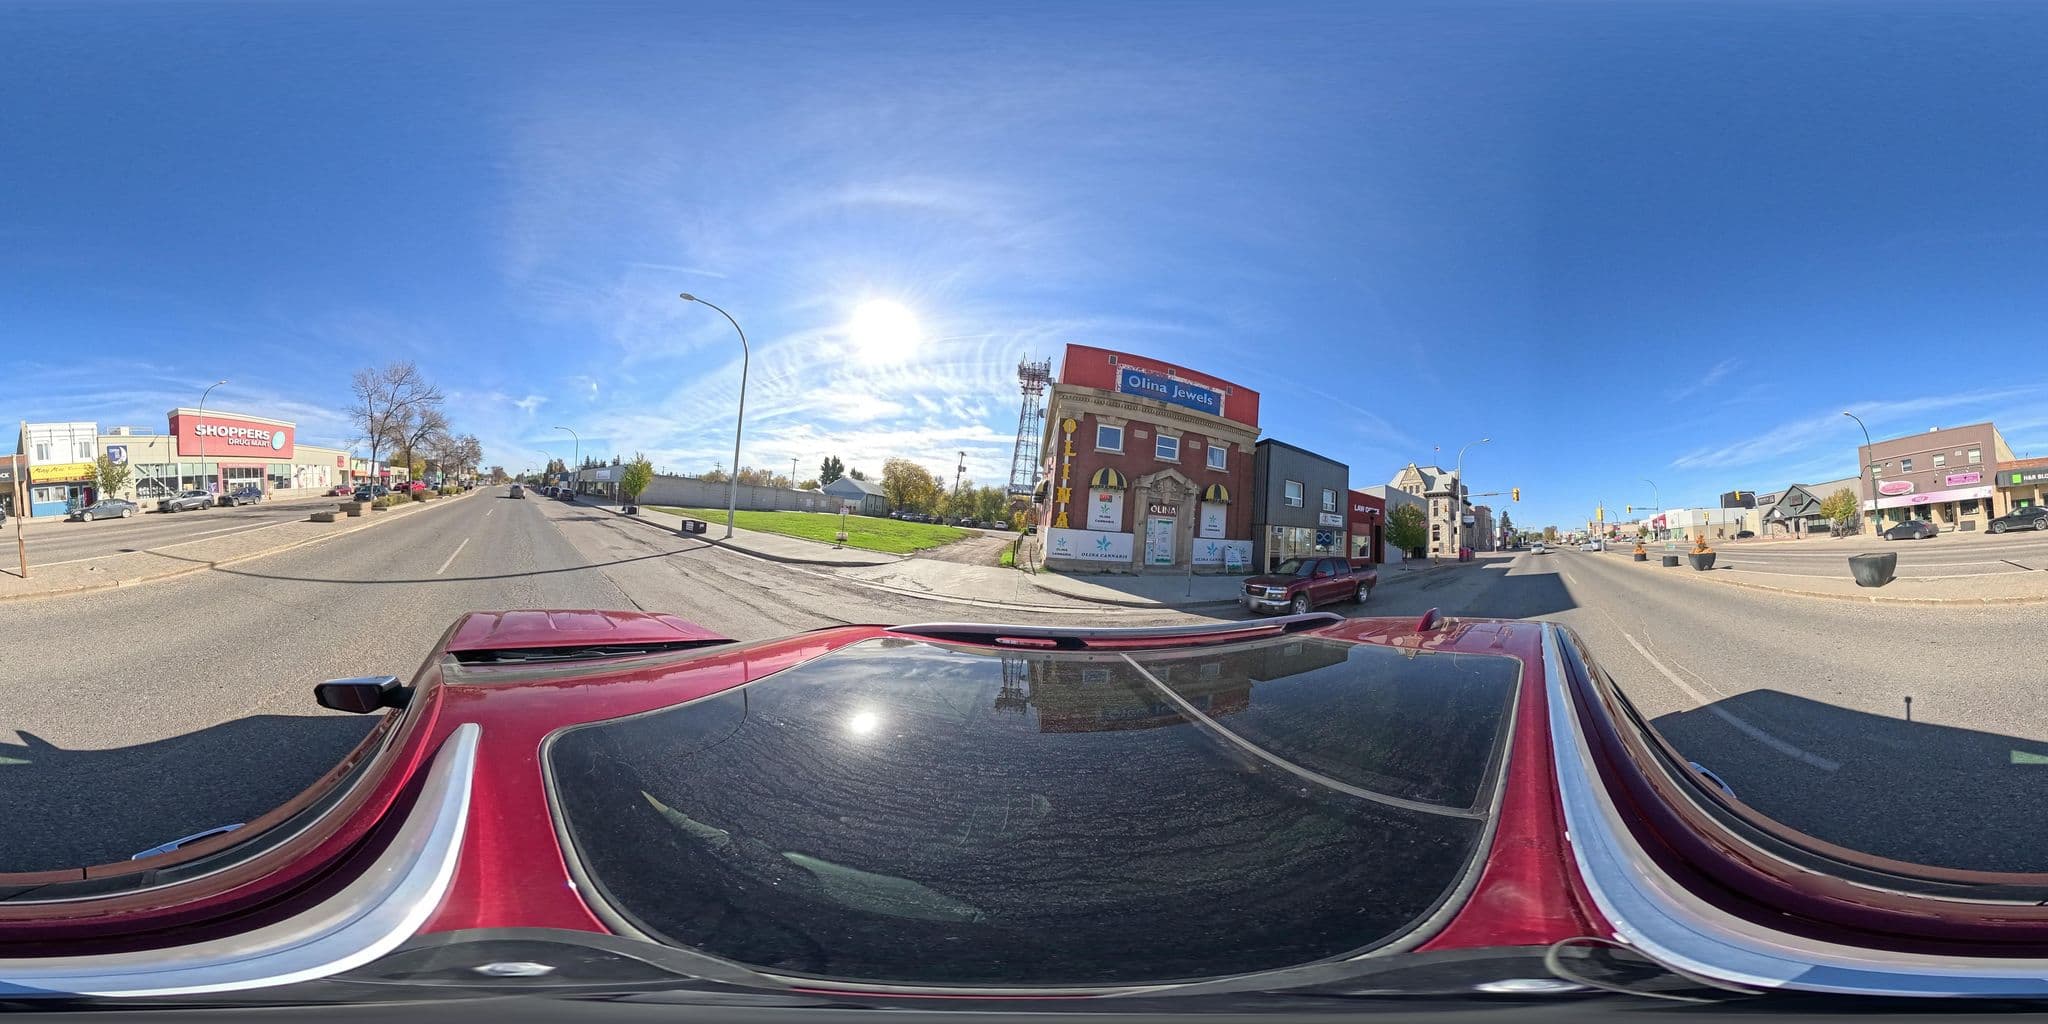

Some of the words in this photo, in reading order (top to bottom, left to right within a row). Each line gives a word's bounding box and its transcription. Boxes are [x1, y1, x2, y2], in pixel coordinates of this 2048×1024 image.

[1128, 375, 1167, 393] Olina
[1172, 385, 1213, 405] Jewels
[195, 424, 270, 441] SHOPPERS
[228, 438, 250, 446] DRUG
[251, 439, 271, 448] MART
[1053, 418, 1077, 528] OLINA
[1150, 505, 1177, 515] OLINA
[1354, 504, 1365, 512] LAW
